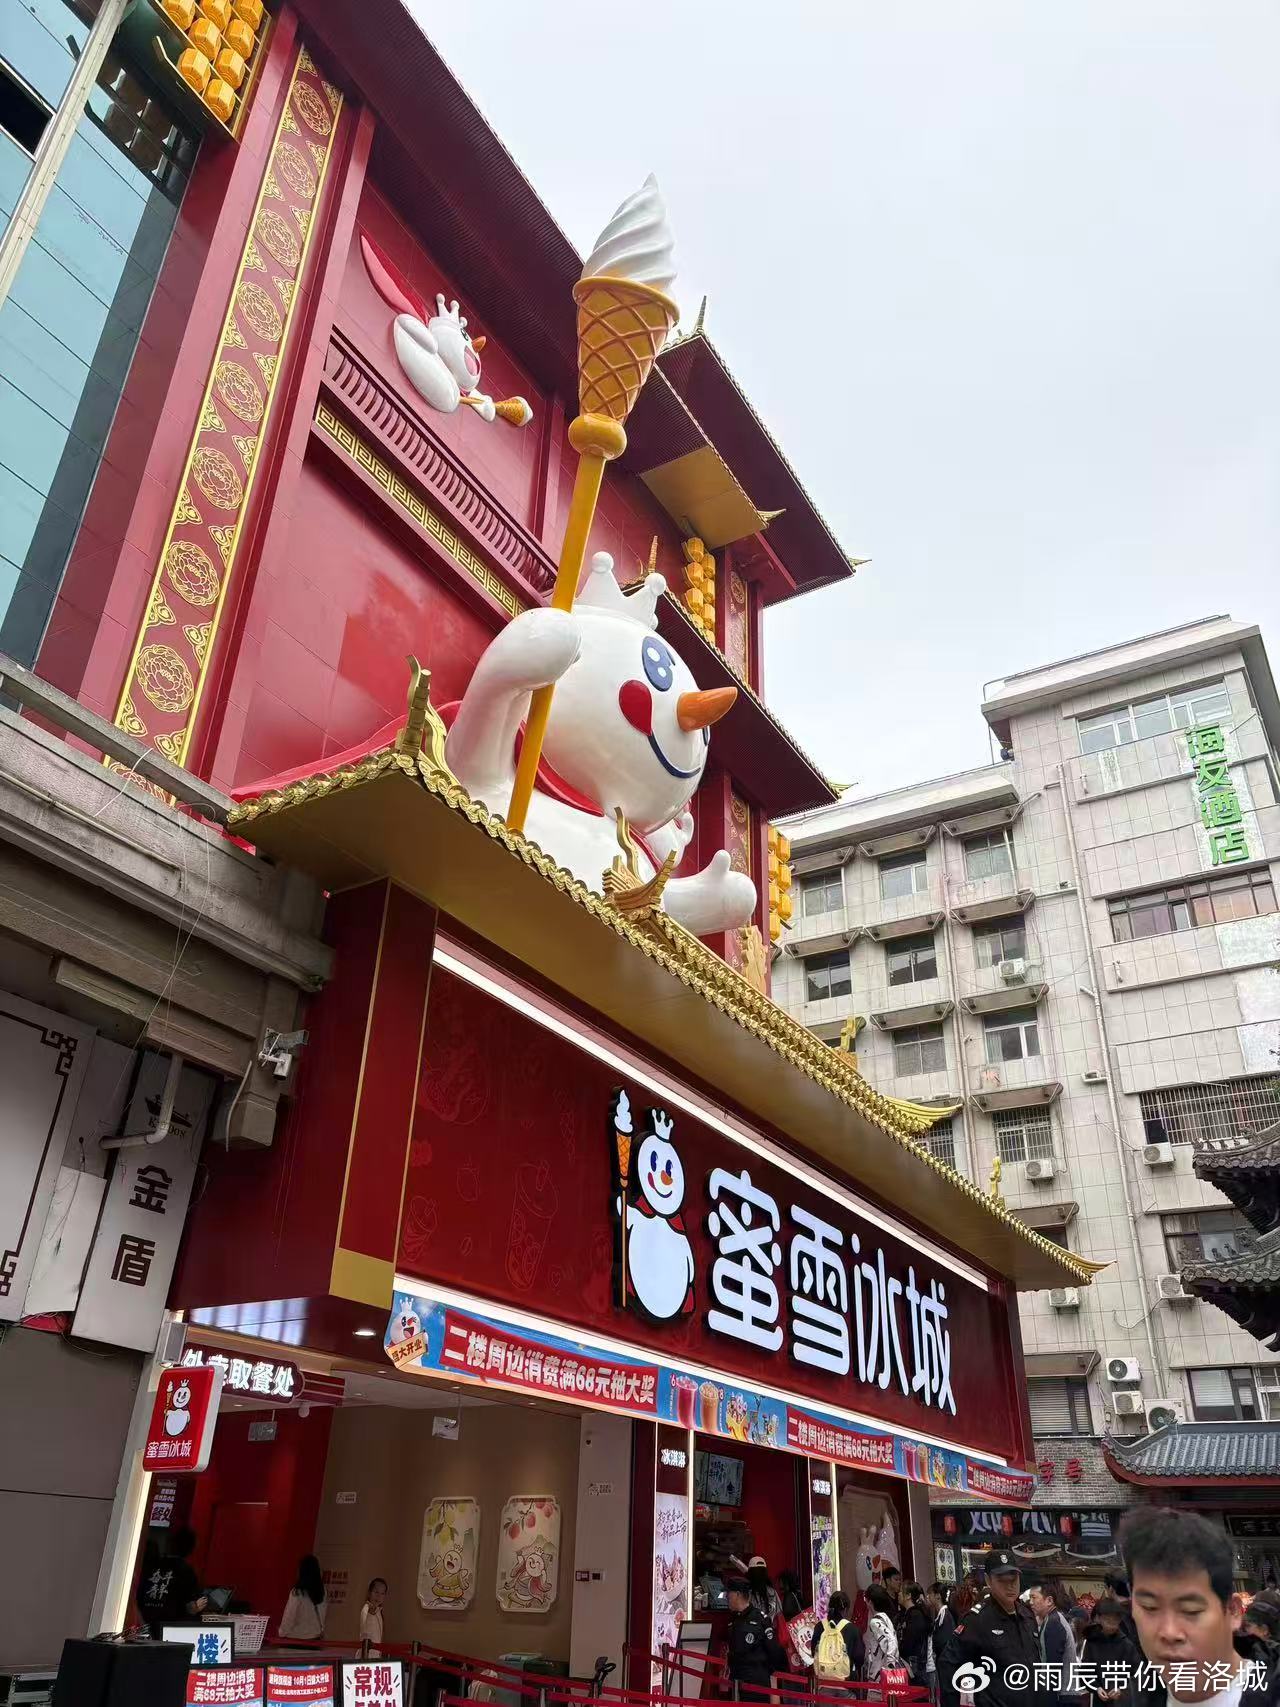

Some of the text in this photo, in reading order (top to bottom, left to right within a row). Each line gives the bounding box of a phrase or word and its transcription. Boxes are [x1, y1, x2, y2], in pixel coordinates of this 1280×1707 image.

[1184, 722, 1249, 866] 海友酒店
[111, 1164, 173, 1287] 金盾
[708, 1167, 956, 1416] 蜜雪冰城
[444, 1325, 655, 1405] 二楼周边消费满68元抽大奖
[146, 1439, 192, 1459] 蜜雪冰城
[788, 1417, 894, 1465] 二楼周边消费满68元抽大奖
[193, 1683, 255, 1702] 满68元抽大奖
[196, 1669, 256, 1687] 二楼周边消费
[354, 1666, 392, 1697] 常规
